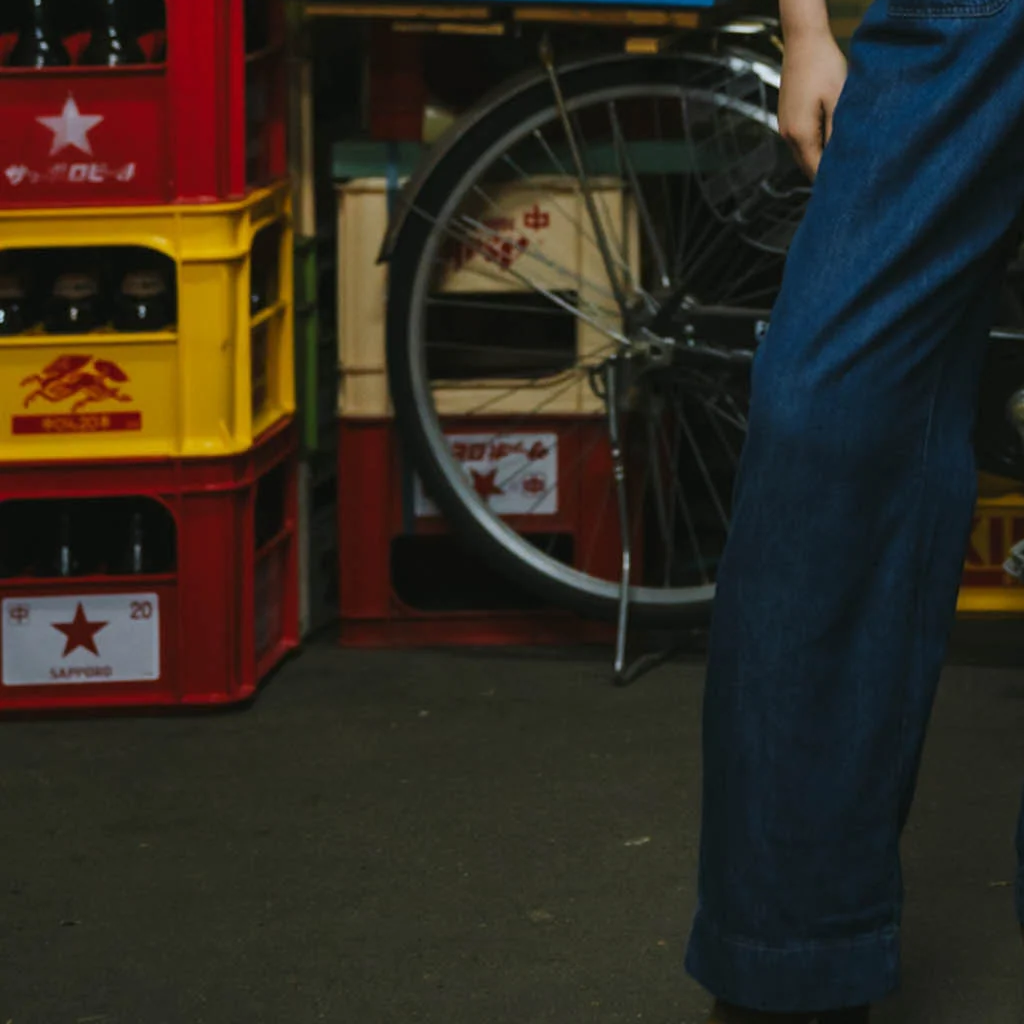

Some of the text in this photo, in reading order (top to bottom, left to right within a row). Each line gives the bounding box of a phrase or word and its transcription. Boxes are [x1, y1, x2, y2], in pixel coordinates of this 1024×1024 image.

[523, 205, 550, 231] 中
[8, 603, 29, 625] 中
[129, 601, 153, 620] 20
[49, 666, 113, 679] SAPPORO
